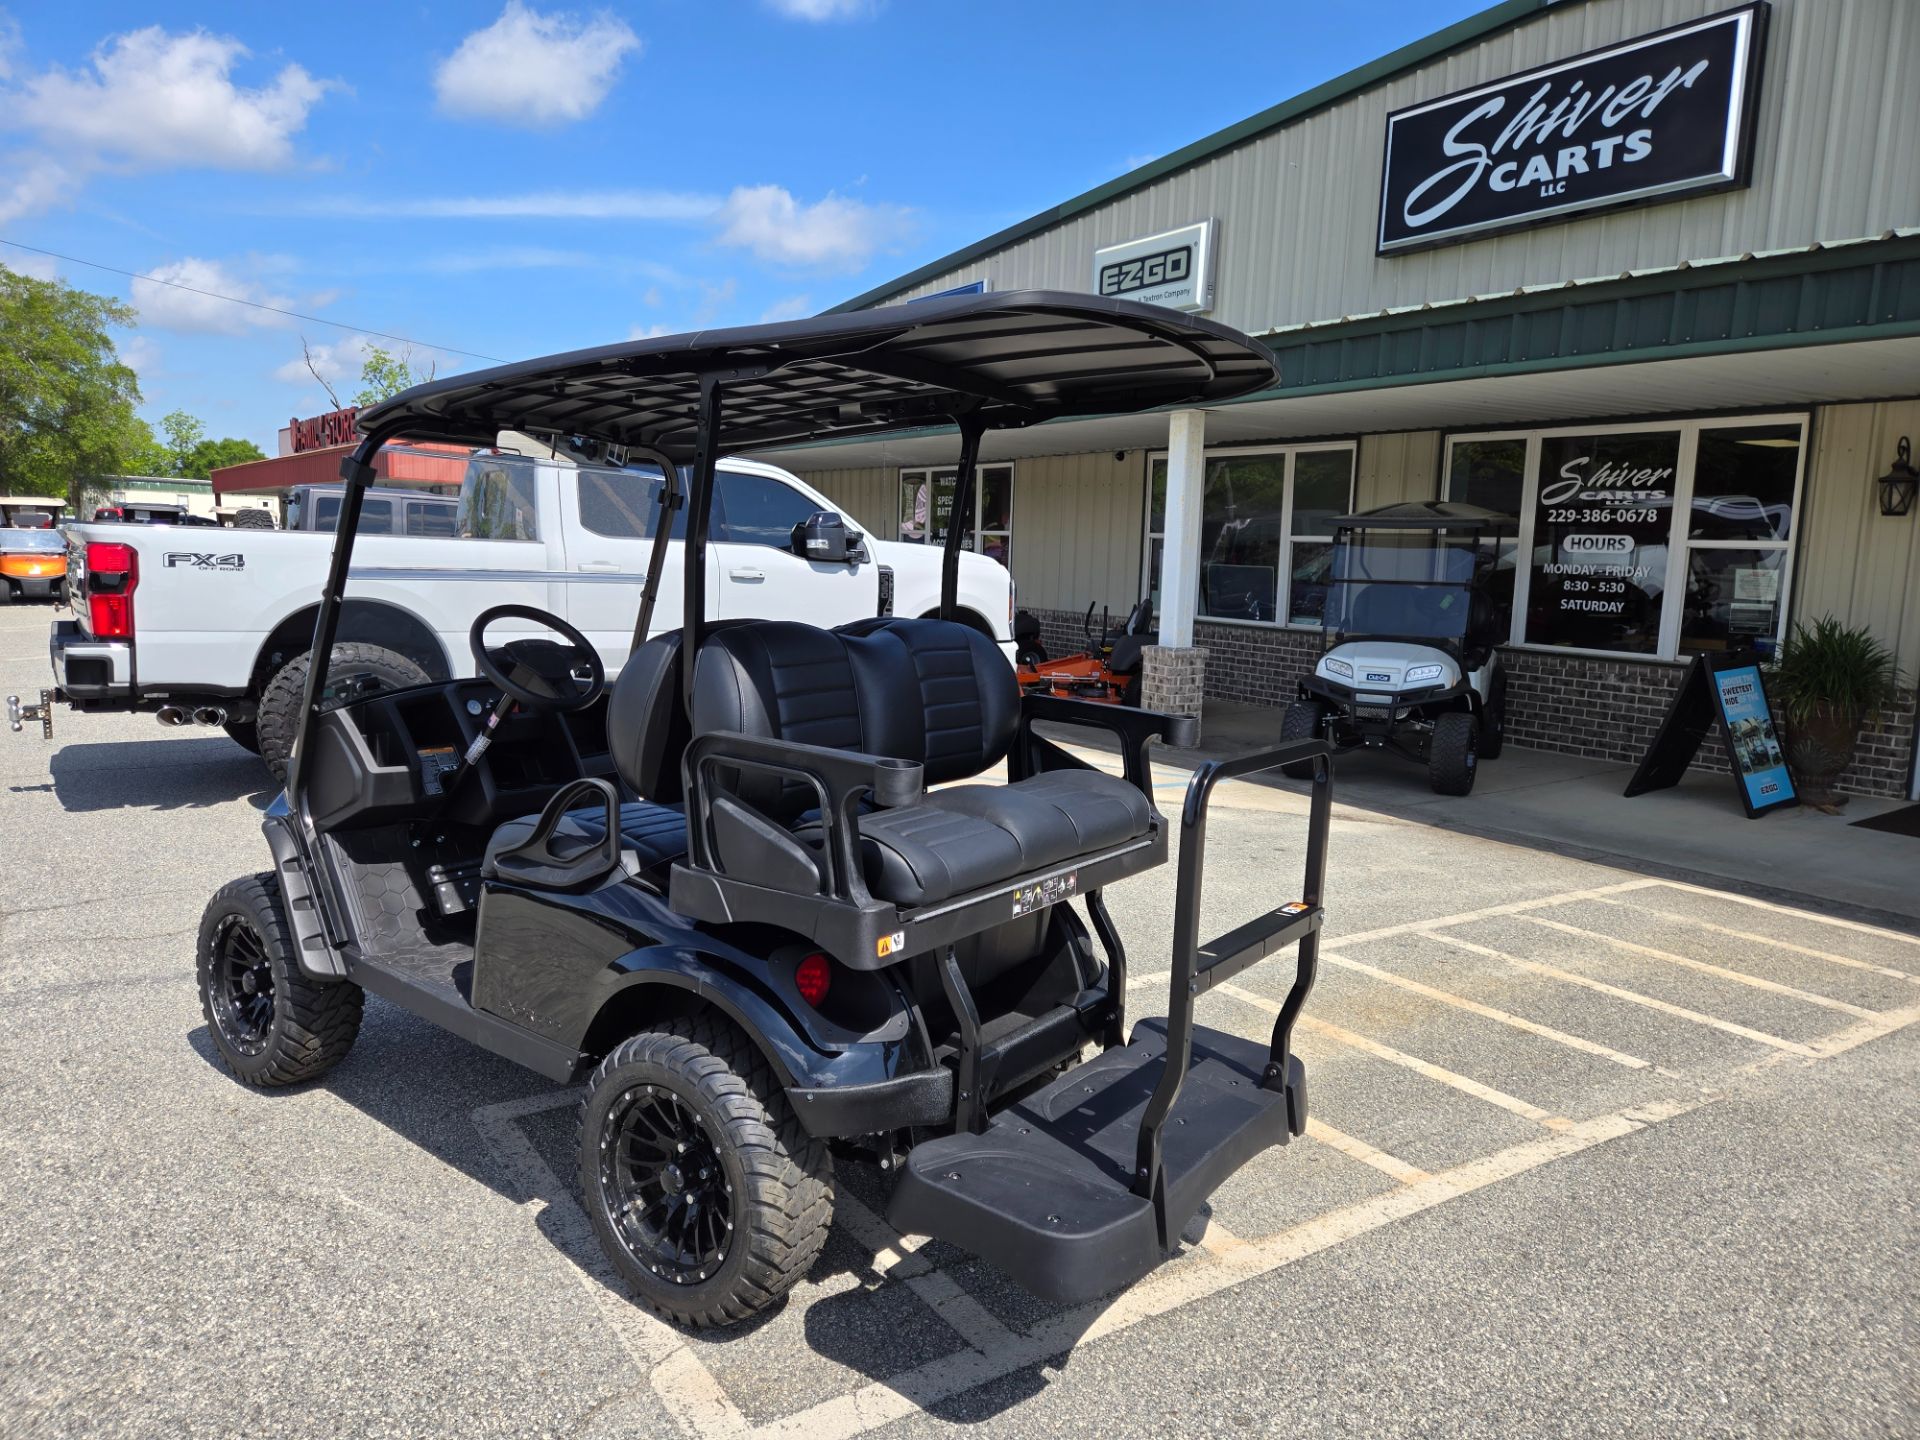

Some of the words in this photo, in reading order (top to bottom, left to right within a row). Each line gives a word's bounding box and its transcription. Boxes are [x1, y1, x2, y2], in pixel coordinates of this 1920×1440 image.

[1404, 59, 1709, 228] Shiver
[1489, 129, 1652, 192] CARTS
[1540, 181, 1566, 198] LLC
[1101, 246, 1191, 296] EZGO
[1164, 288, 1191, 299] Company
[325, 406, 358, 444] STORE
[1541, 456, 1672, 505] Shiver
[1578, 489, 1666, 501] CARTS
[1547, 509, 1657, 523] 229-386-0678
[1570, 537, 1626, 551] HOURS
[163, 552, 245, 568] FX4
[1543, 563, 1597, 576] MONDAY
[1605, 565, 1651, 578] FRIDAY
[1563, 580, 1589, 592] 8:30
[1598, 582, 1625, 593] 5:30
[1560, 599, 1624, 613] SATURDAY
[1722, 683, 1752, 697] SWEETEST
[1725, 696, 1739, 706] RIDE
